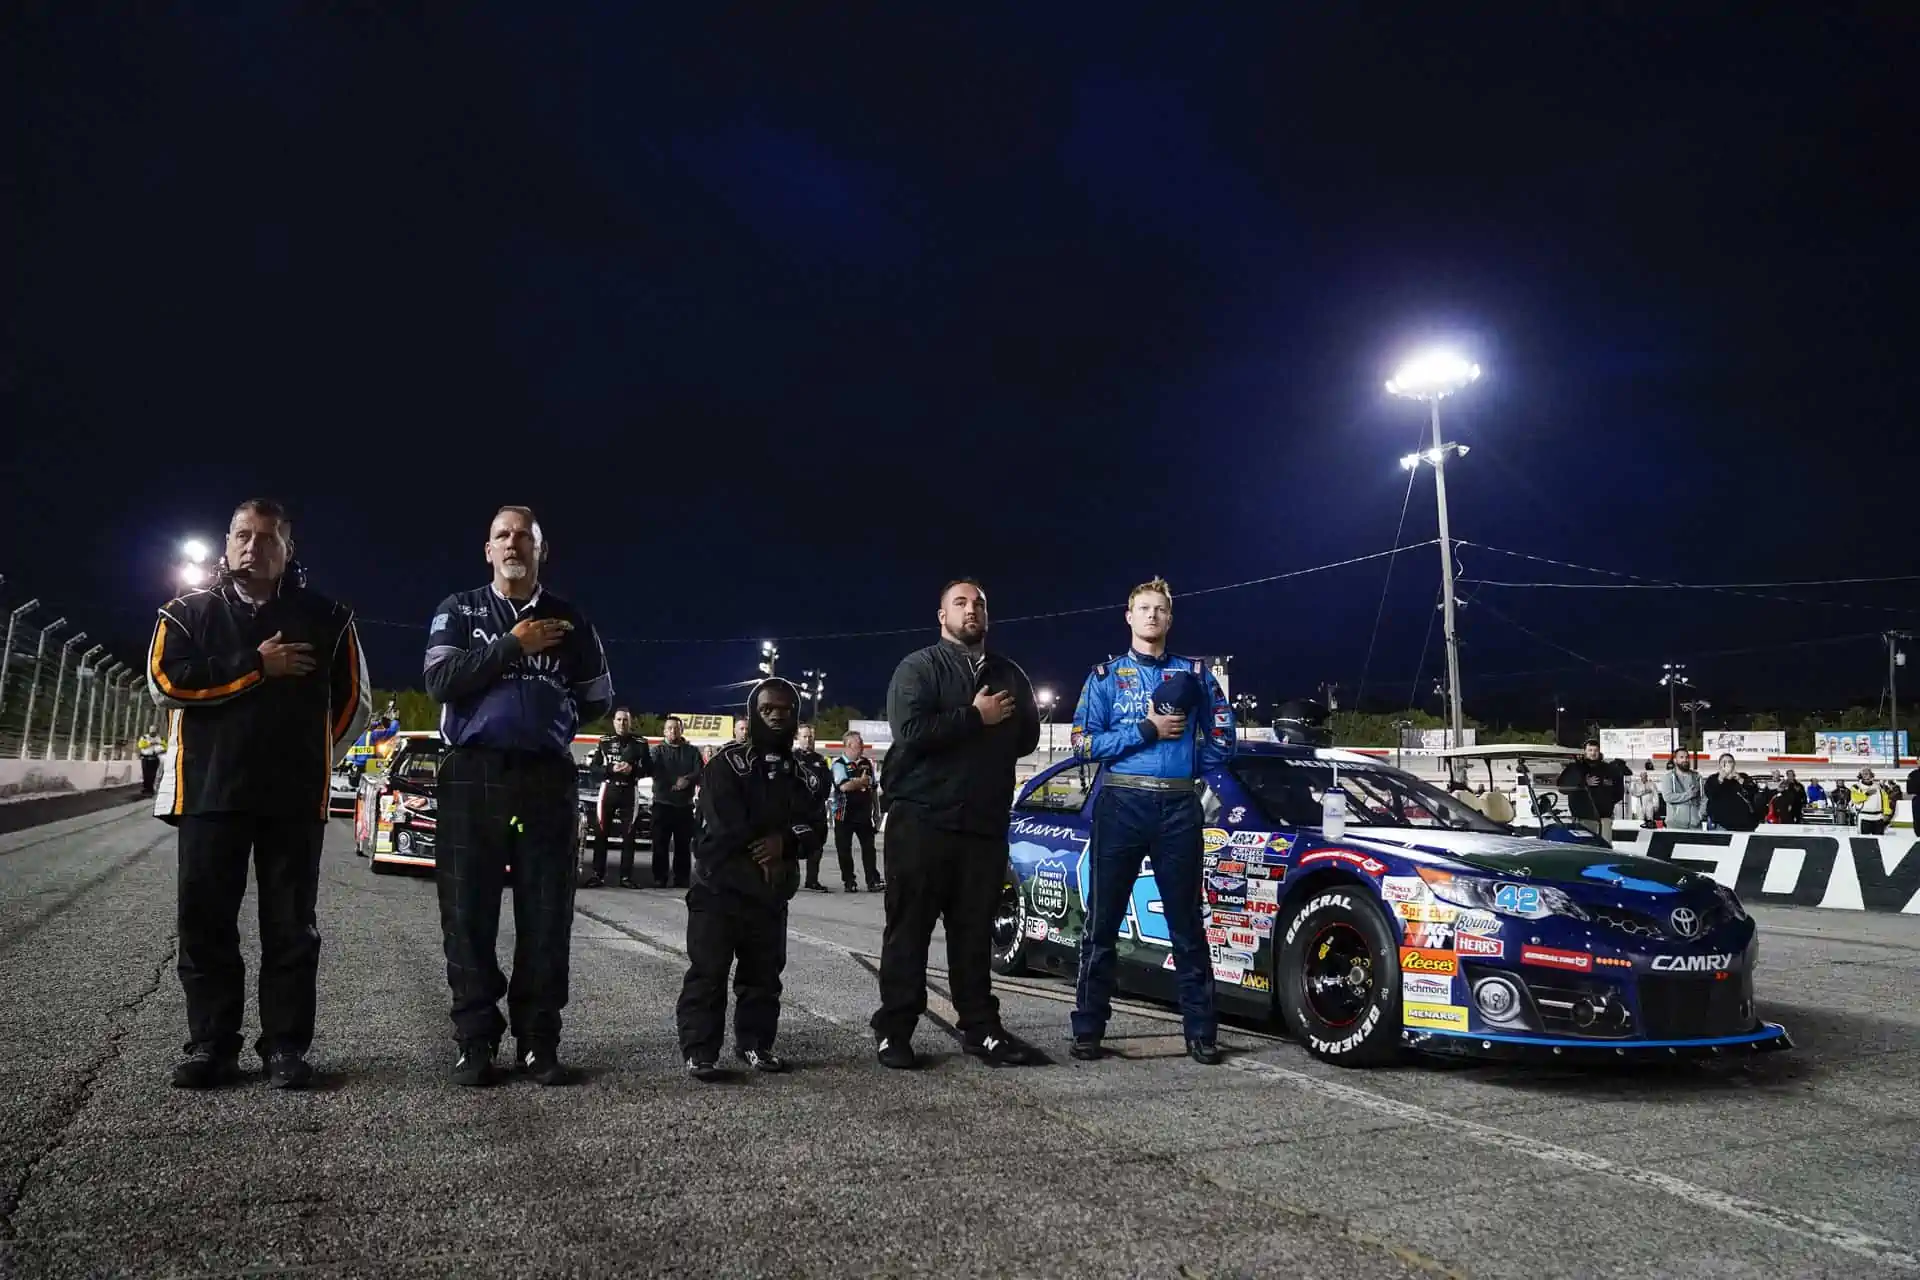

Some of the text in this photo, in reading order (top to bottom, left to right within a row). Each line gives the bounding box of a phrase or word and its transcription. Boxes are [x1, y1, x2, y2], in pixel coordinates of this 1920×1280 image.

[683, 715, 722, 730] JEGS
[1039, 879, 1063, 890] ROADS
[1038, 897, 1062, 909] HOME
[1494, 884, 1540, 912] 42
[1247, 901, 1279, 914] ARP
[1286, 894, 1352, 944] GENERAL
[1003, 895, 1026, 963] GENERAL
[1651, 953, 1733, 971] CAMRY
[1404, 982, 1449, 996] Richmond
[1309, 1004, 1381, 1054] GENERAL
